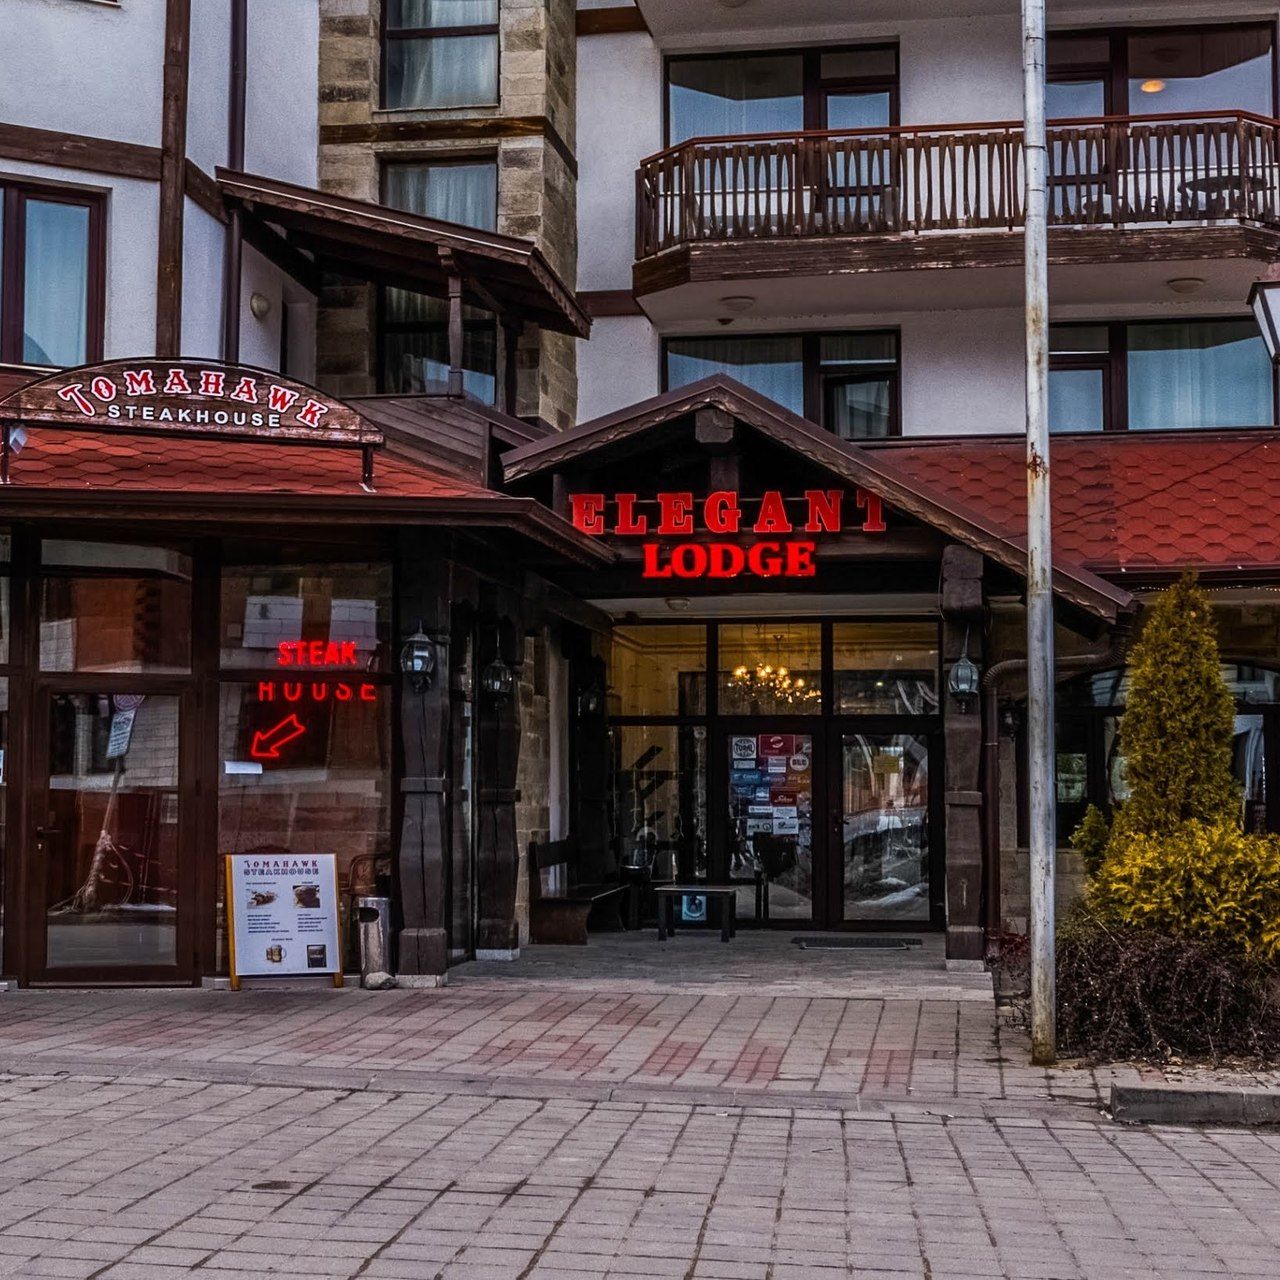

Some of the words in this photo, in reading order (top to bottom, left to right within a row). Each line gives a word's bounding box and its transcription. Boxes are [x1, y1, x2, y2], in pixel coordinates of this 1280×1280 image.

[58, 369, 328, 428] TOMAHAWK
[108, 404, 281, 427] STEAKHOUSE
[569, 490, 887, 535] ELEGANT
[641, 541, 816, 579] LODGE
[277, 640, 358, 667] STEAK
[258, 682, 377, 702] HOUSE
[243, 860, 318, 868] TOMAHAWK
[243, 868, 319, 876] STEAKHOUSE
